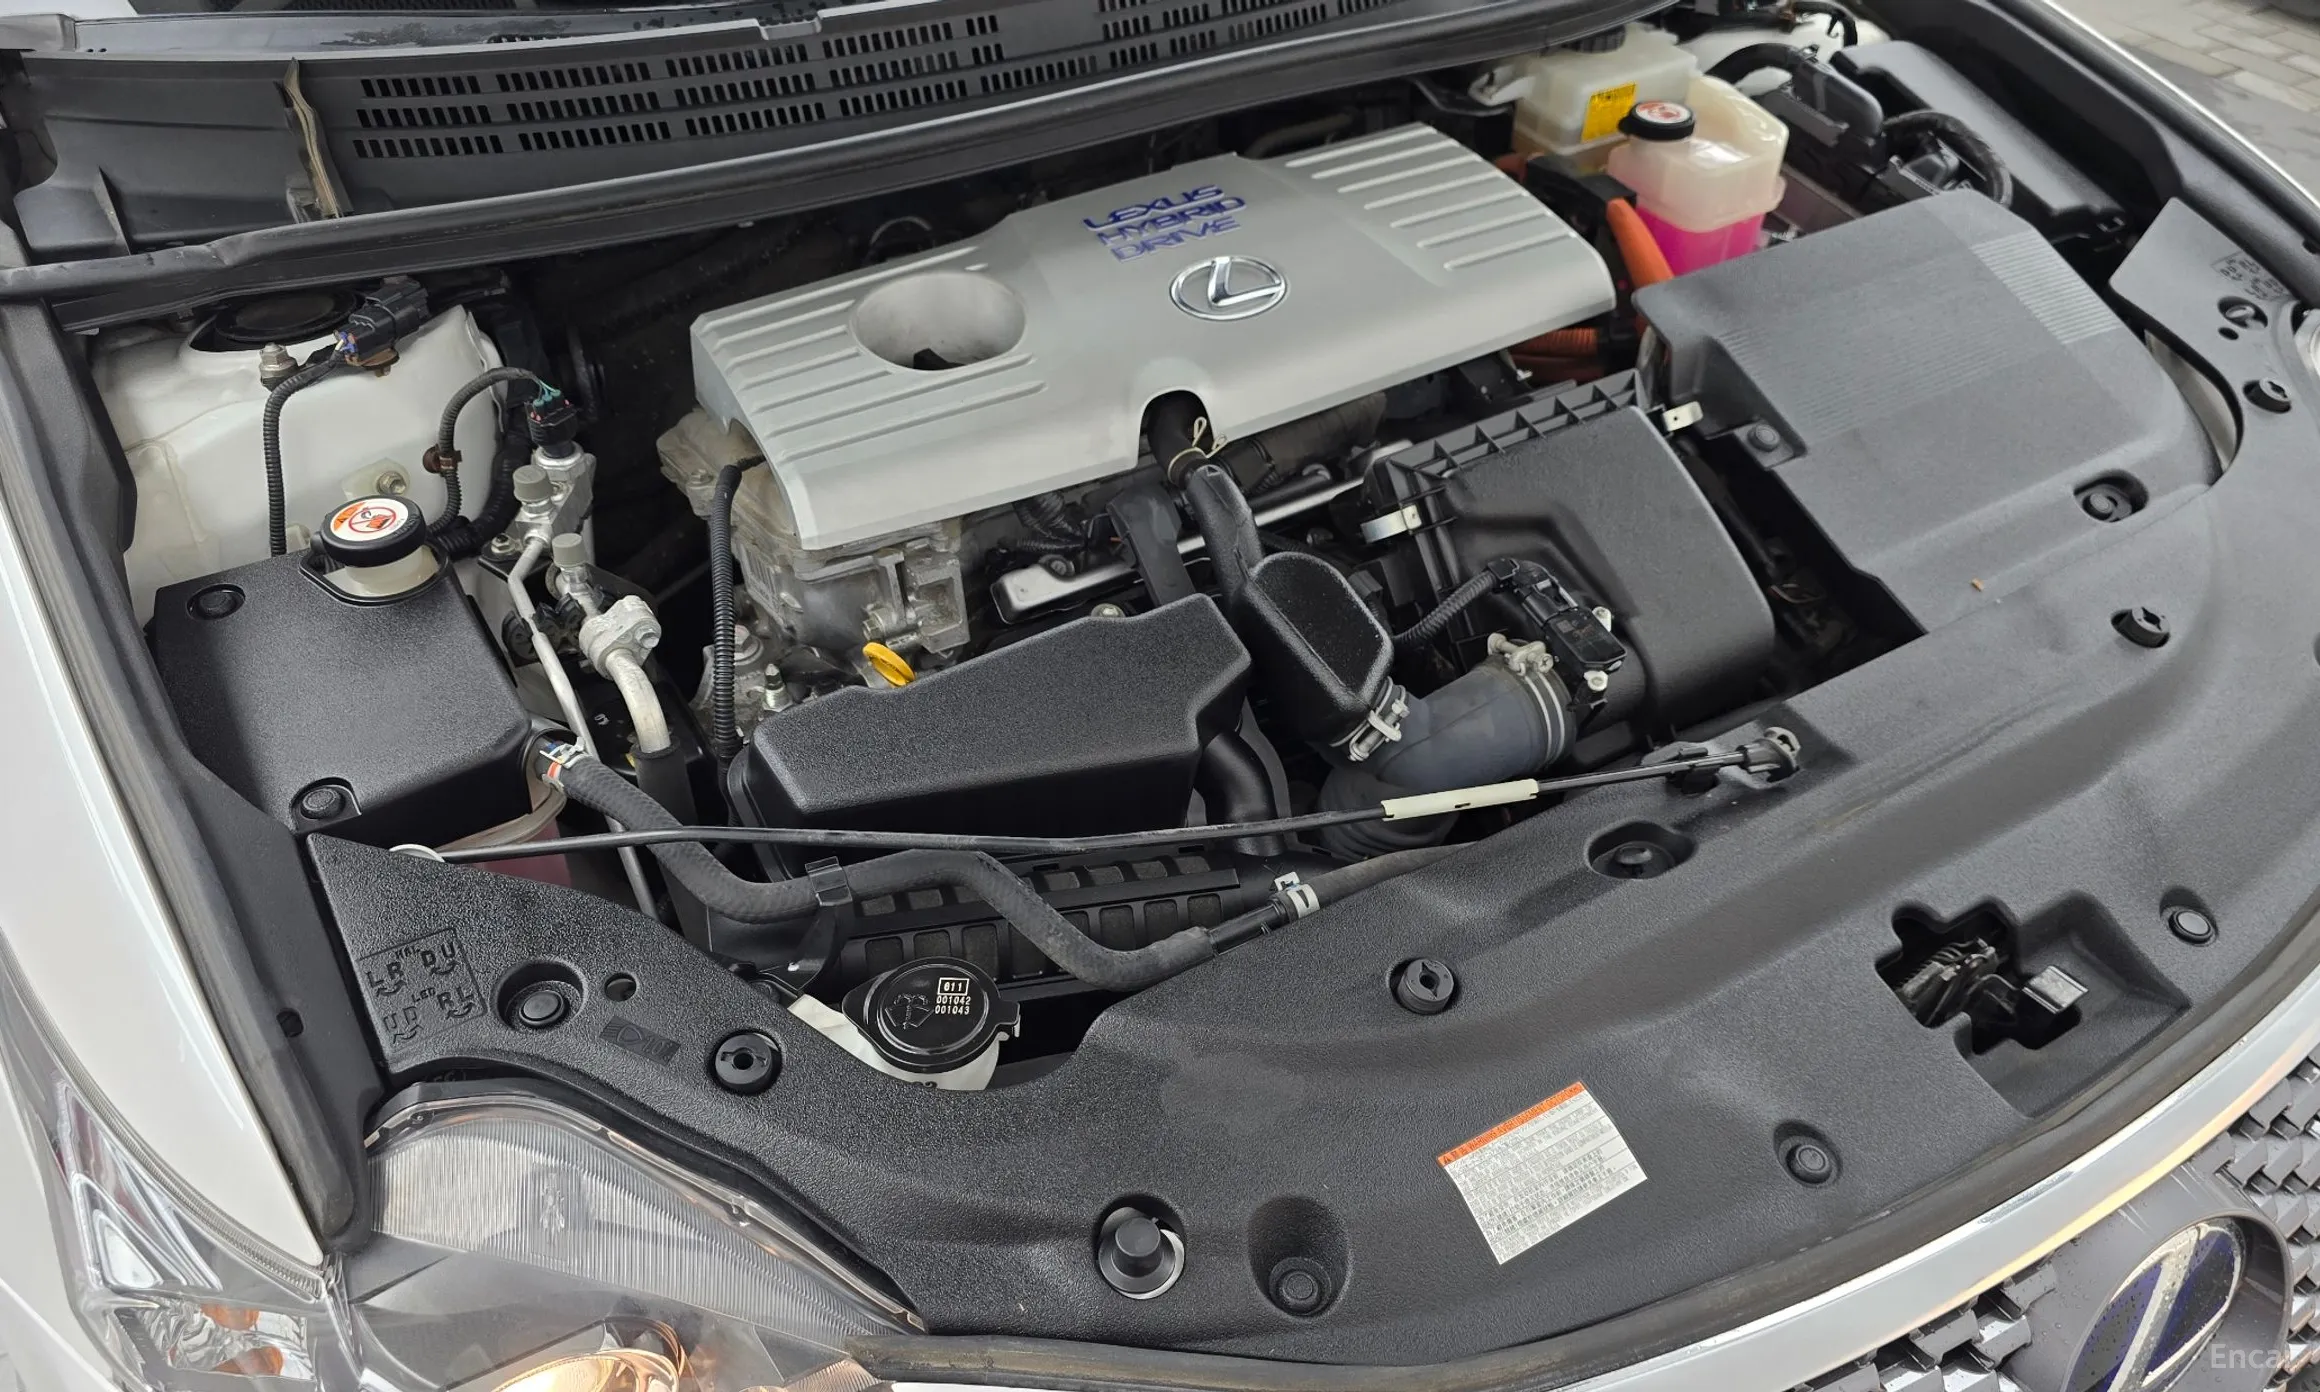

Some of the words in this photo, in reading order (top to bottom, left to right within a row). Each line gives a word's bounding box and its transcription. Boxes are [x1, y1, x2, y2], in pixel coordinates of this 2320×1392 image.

[1083, 185, 1225, 231] LEXUS
[1097, 197, 1247, 247] HYBRID
[1111, 216, 1240, 262] DRIVE
[935, 1004, 970, 1015] 001043
[936, 995, 971, 1005] 001042
